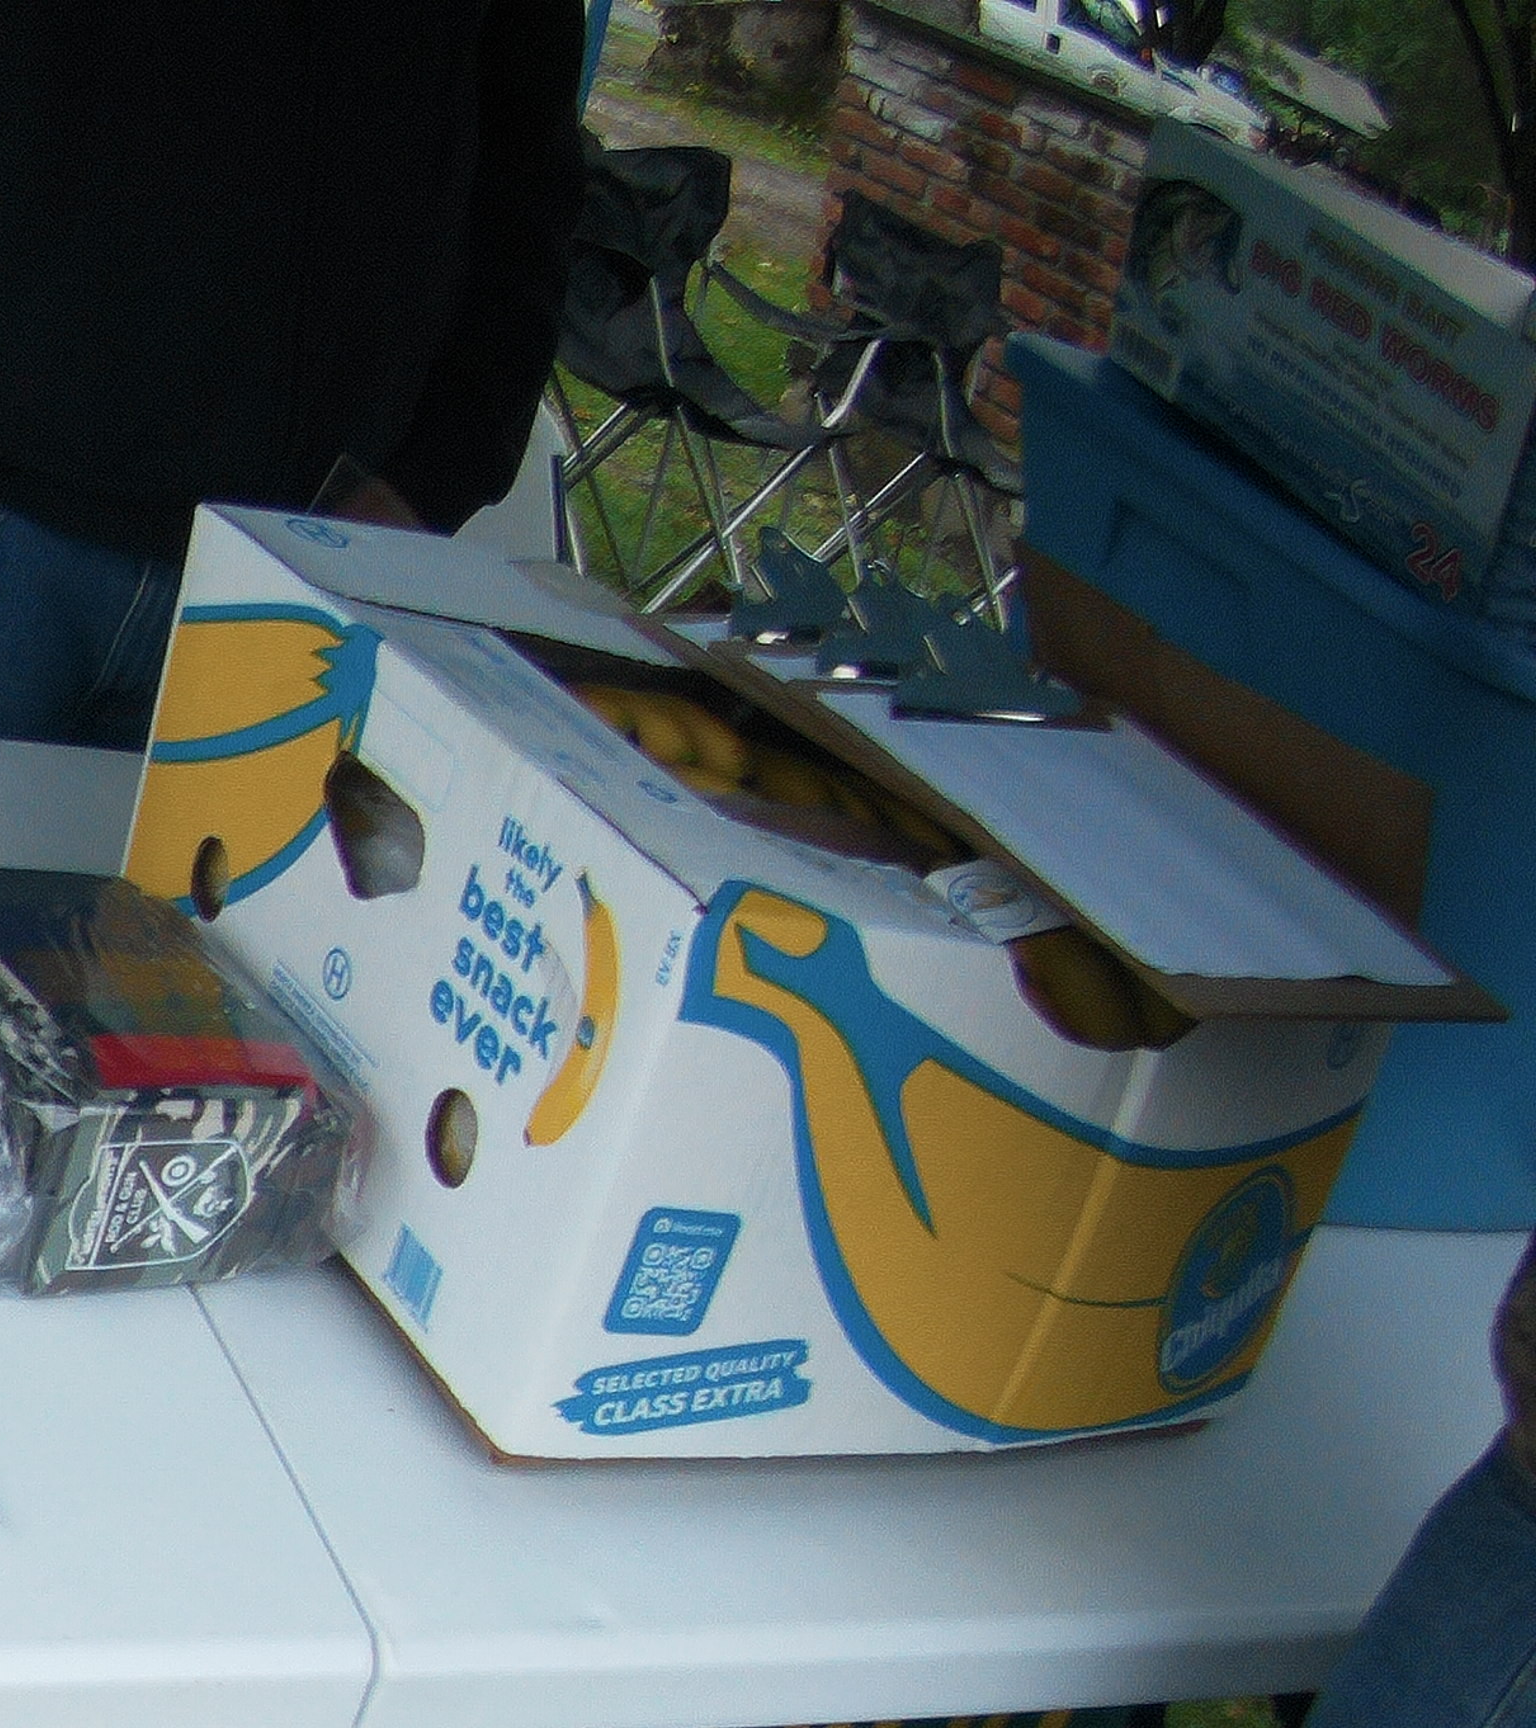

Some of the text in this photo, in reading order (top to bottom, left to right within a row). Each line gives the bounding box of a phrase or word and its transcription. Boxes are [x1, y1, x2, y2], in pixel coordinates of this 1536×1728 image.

[498, 814, 563, 894] likely
[504, 868, 535, 908] the
[459, 864, 546, 973] best
[429, 980, 522, 1085] ever
[450, 937, 557, 1059] snack
[591, 1352, 797, 1394] SELECTED QUALITY
[594, 1378, 784, 1426] CLASS EXTRA
